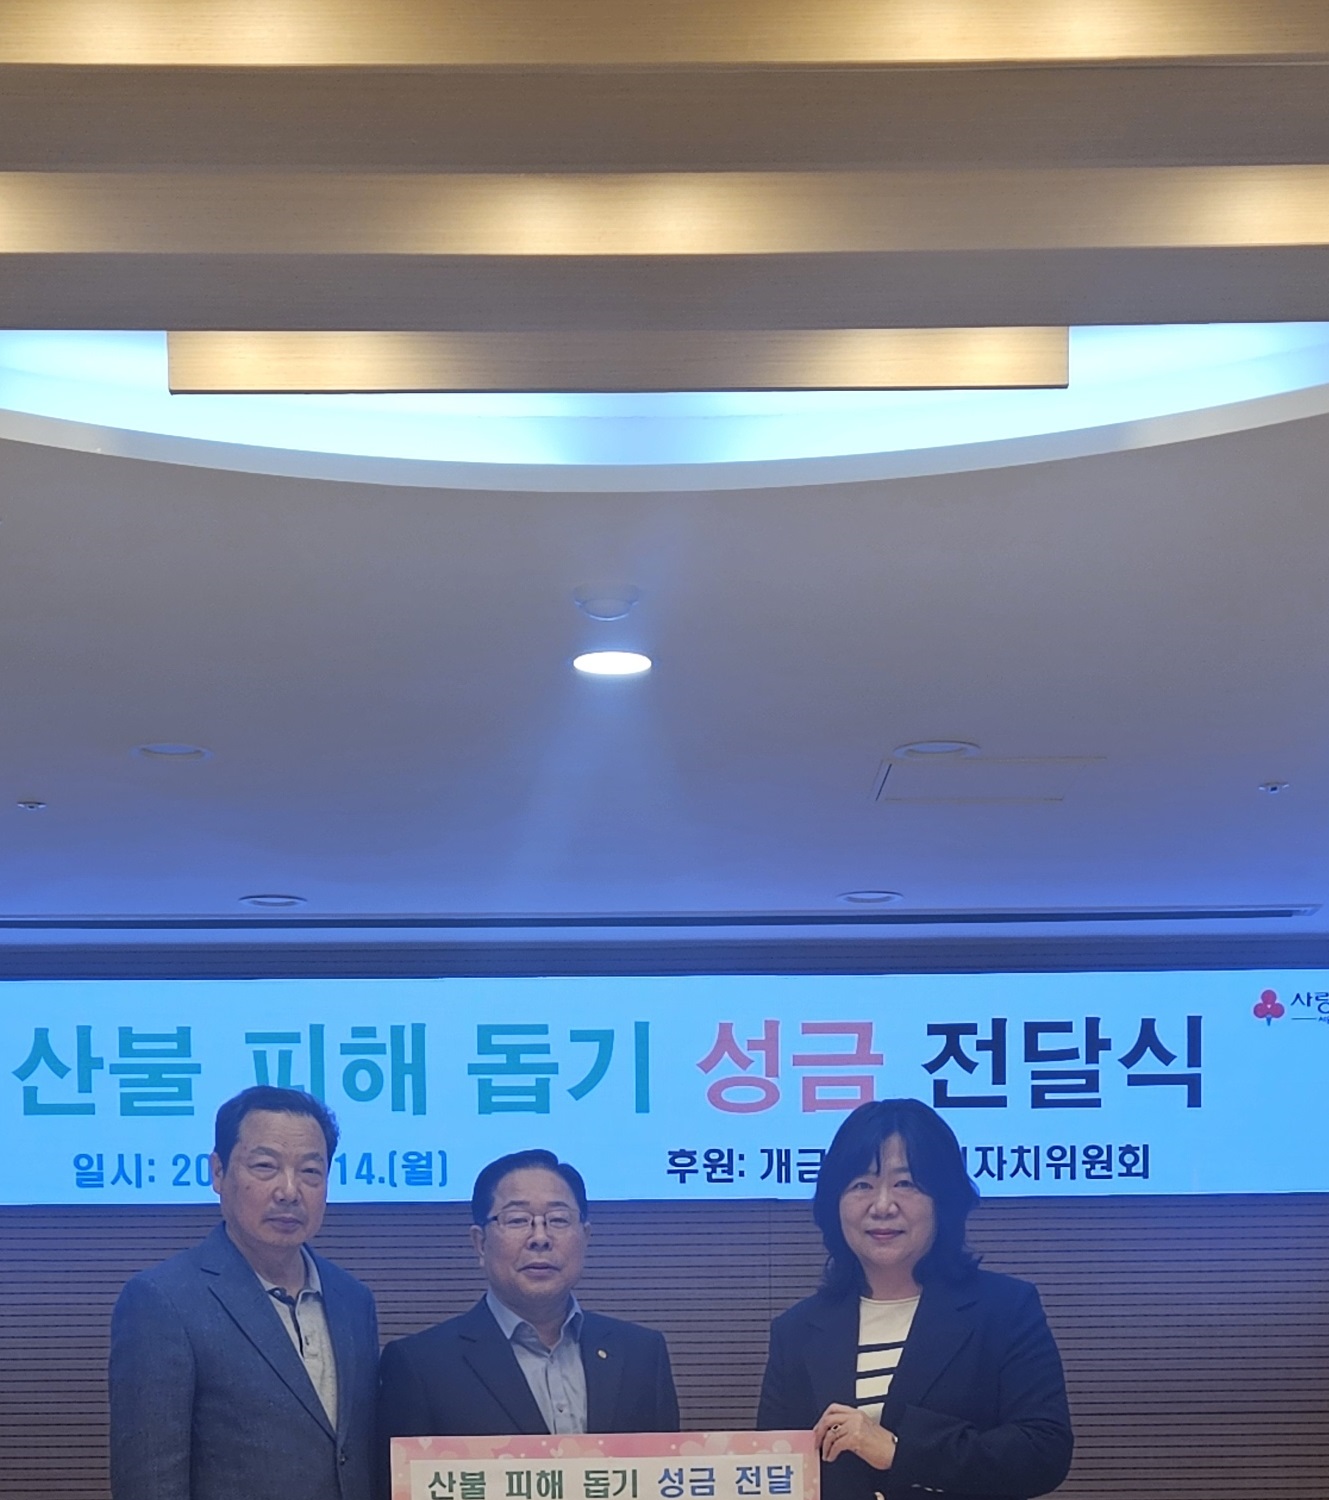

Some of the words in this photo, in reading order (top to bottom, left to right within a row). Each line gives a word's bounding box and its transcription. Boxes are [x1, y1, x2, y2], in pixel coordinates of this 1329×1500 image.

[12, 1023, 202, 1117] 산불
[245, 1022, 427, 1116] 피해
[467, 1020, 651, 1115] 돕기
[696, 1019, 884, 1114] 성금
[921, 1015, 1203, 1109] 전달식
[73, 1153, 156, 1189] 일시:
[667, 1148, 745, 1184] 후원:
[760, 1148, 826, 1184] 개금
[961, 1144, 1150, 1182] 자치위원회
[427, 1470, 487, 1500] 산불
[505, 1468, 565, 1500] 피해
[583, 1468, 639, 1499] 돕기
[658, 1466, 717, 1498] 성금
[735, 1464, 794, 1495] 전달
